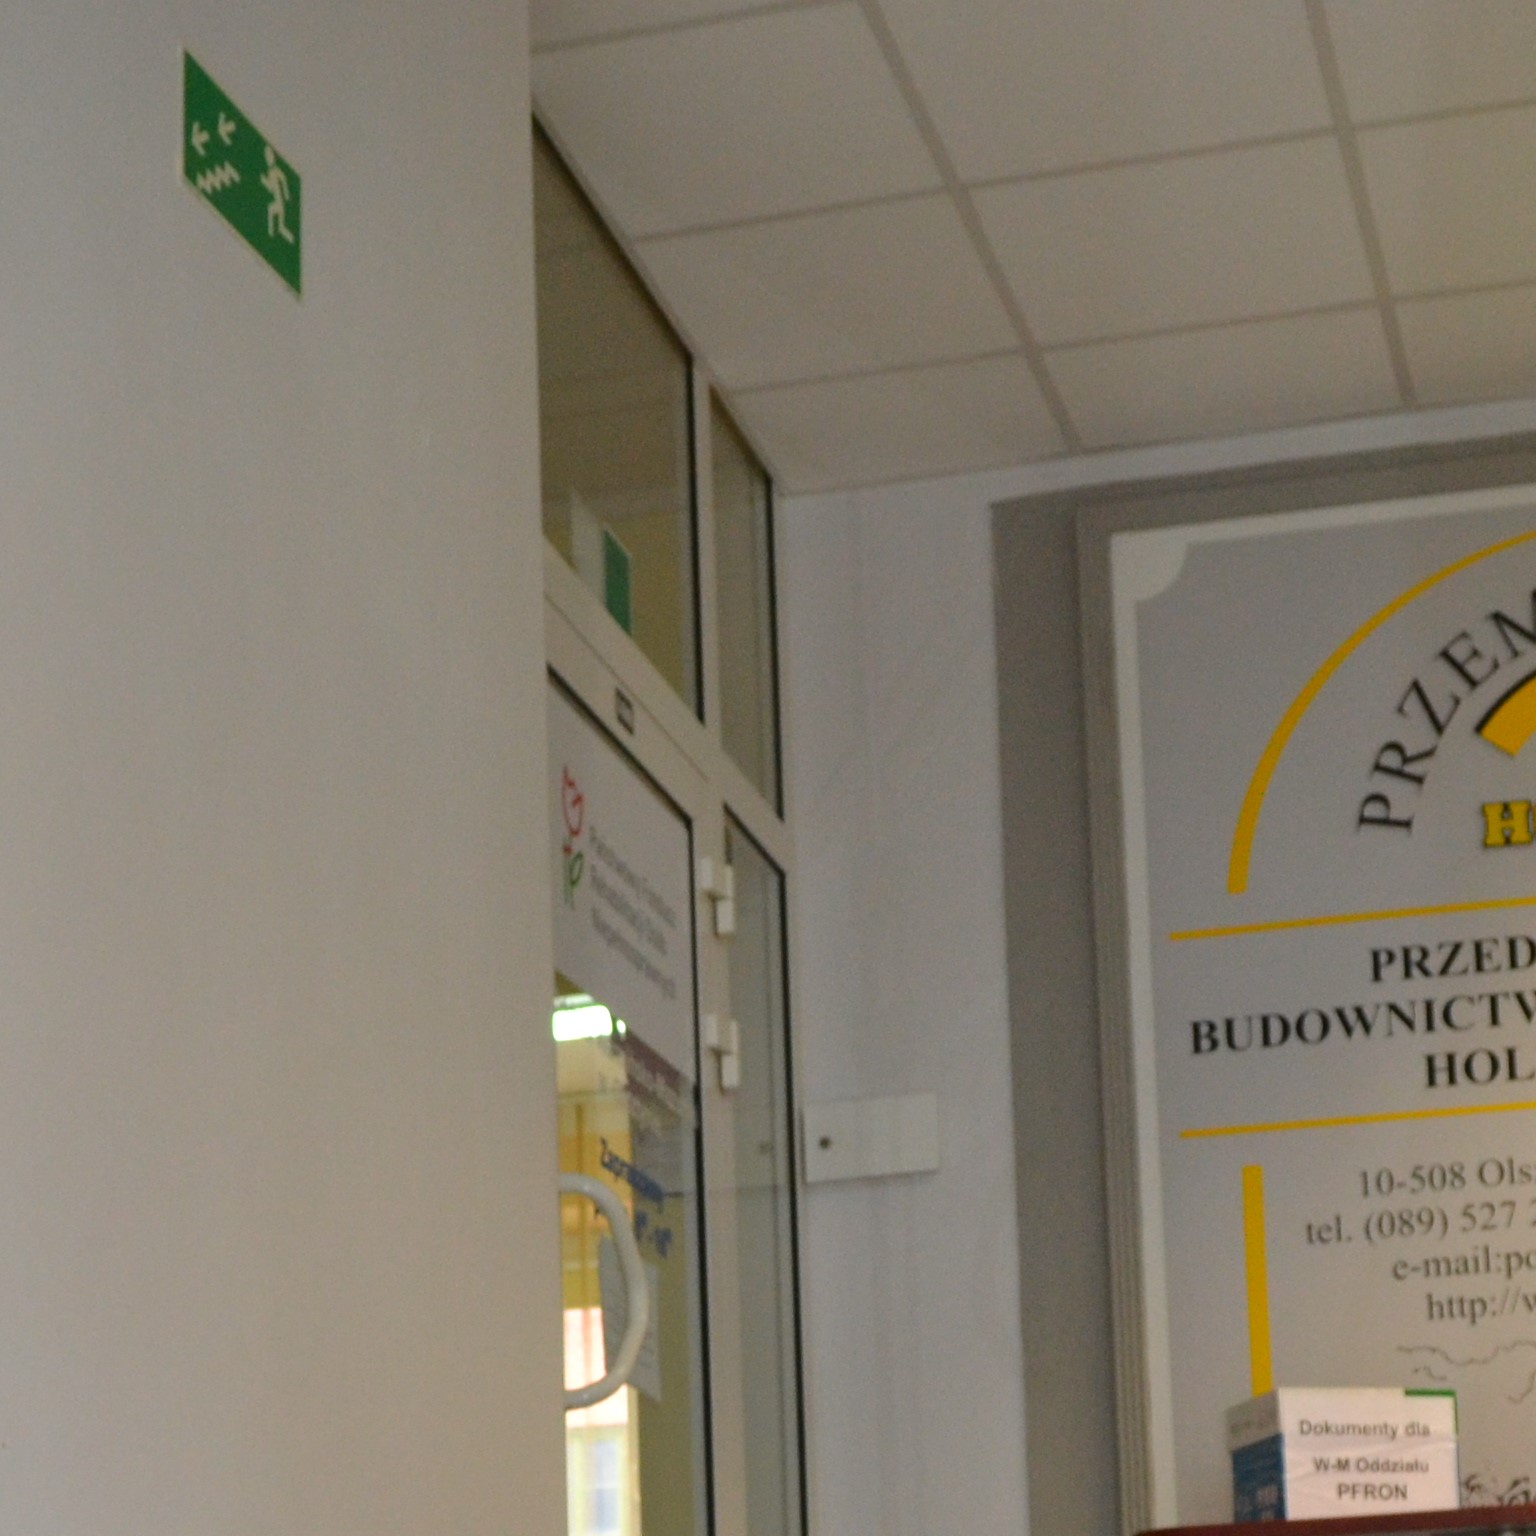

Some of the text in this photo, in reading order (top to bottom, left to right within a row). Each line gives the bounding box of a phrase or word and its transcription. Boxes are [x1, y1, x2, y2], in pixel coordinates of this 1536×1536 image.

[1359, 1164, 1466, 1199] 10-508
[1306, 1213, 1353, 1246] tel.
[1363, 1205, 1451, 1244] (089)
[1462, 1199, 1517, 1231] 527
[1299, 1419, 1397, 1440] Dokumenty
[1405, 1420, 1431, 1437] dla
[1313, 1457, 1430, 1473] W-M Oddziału
[1337, 1483, 1408, 1500] PFRON
